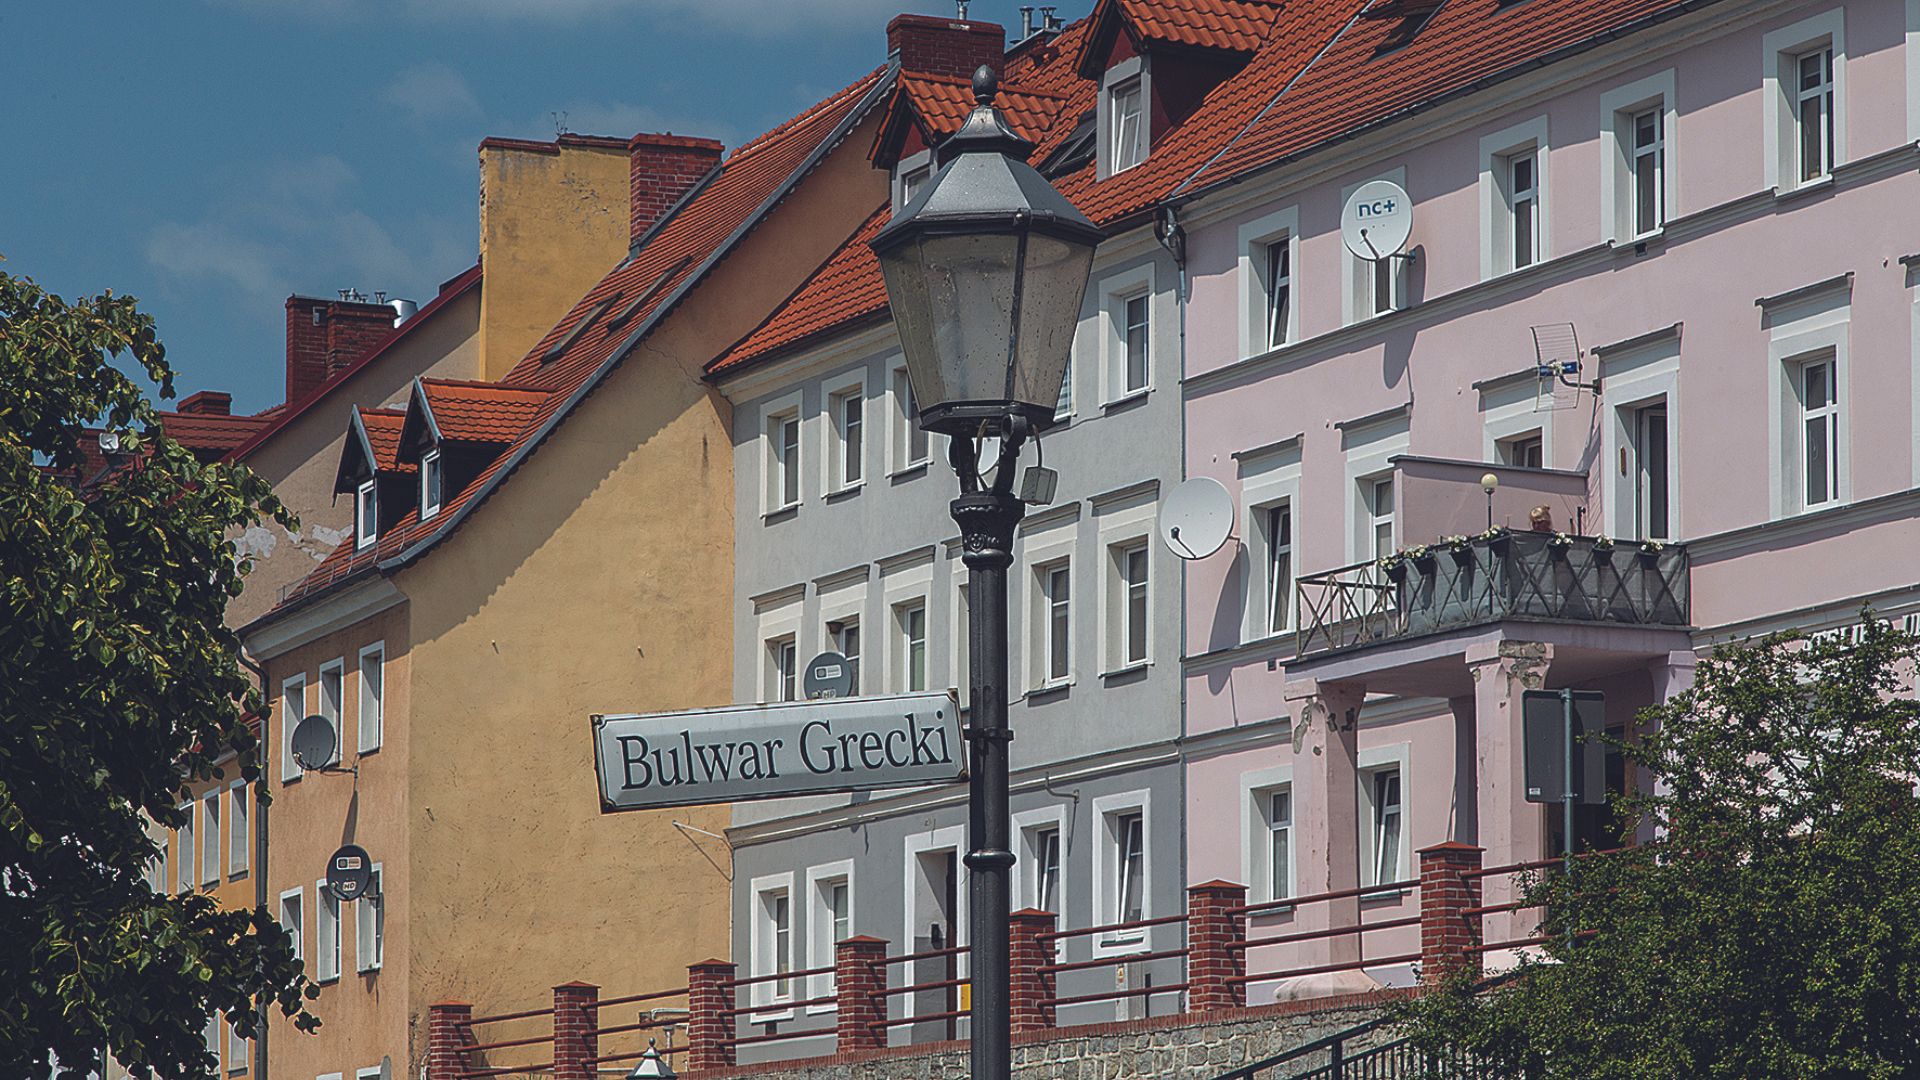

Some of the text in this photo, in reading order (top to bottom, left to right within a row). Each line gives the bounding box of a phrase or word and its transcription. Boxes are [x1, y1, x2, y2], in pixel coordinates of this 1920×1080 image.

[1358, 199, 1395, 217] nc+
[615, 709, 952, 790] Bulwar Grecki
